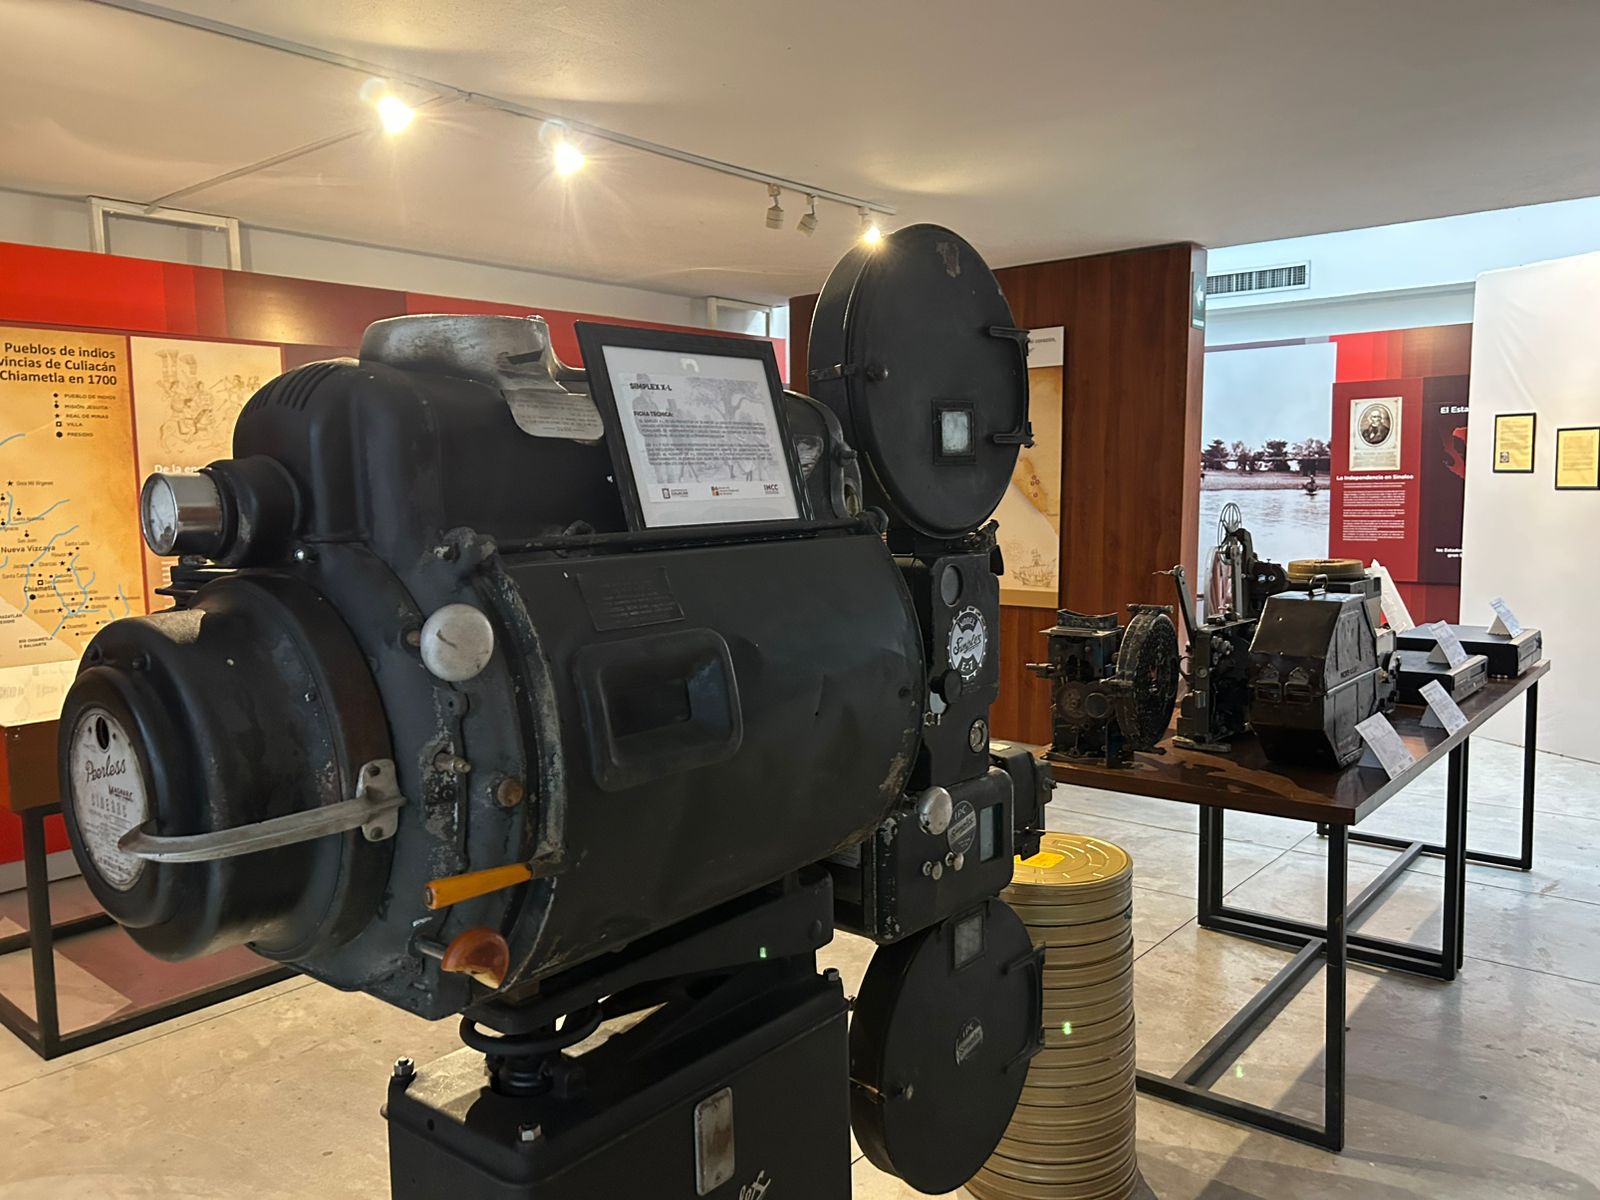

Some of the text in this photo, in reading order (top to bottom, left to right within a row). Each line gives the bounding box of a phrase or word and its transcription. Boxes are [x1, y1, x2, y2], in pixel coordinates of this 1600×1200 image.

[5, 342, 116, 359] Pueblos de indios
[45, 359, 61, 369] de
[65, 360, 116, 372] Culiacán
[0, 370, 117, 385] Chiametla en 1700
[1440, 406, 1450, 414] El
[85, 755, 127, 784] Peerless
